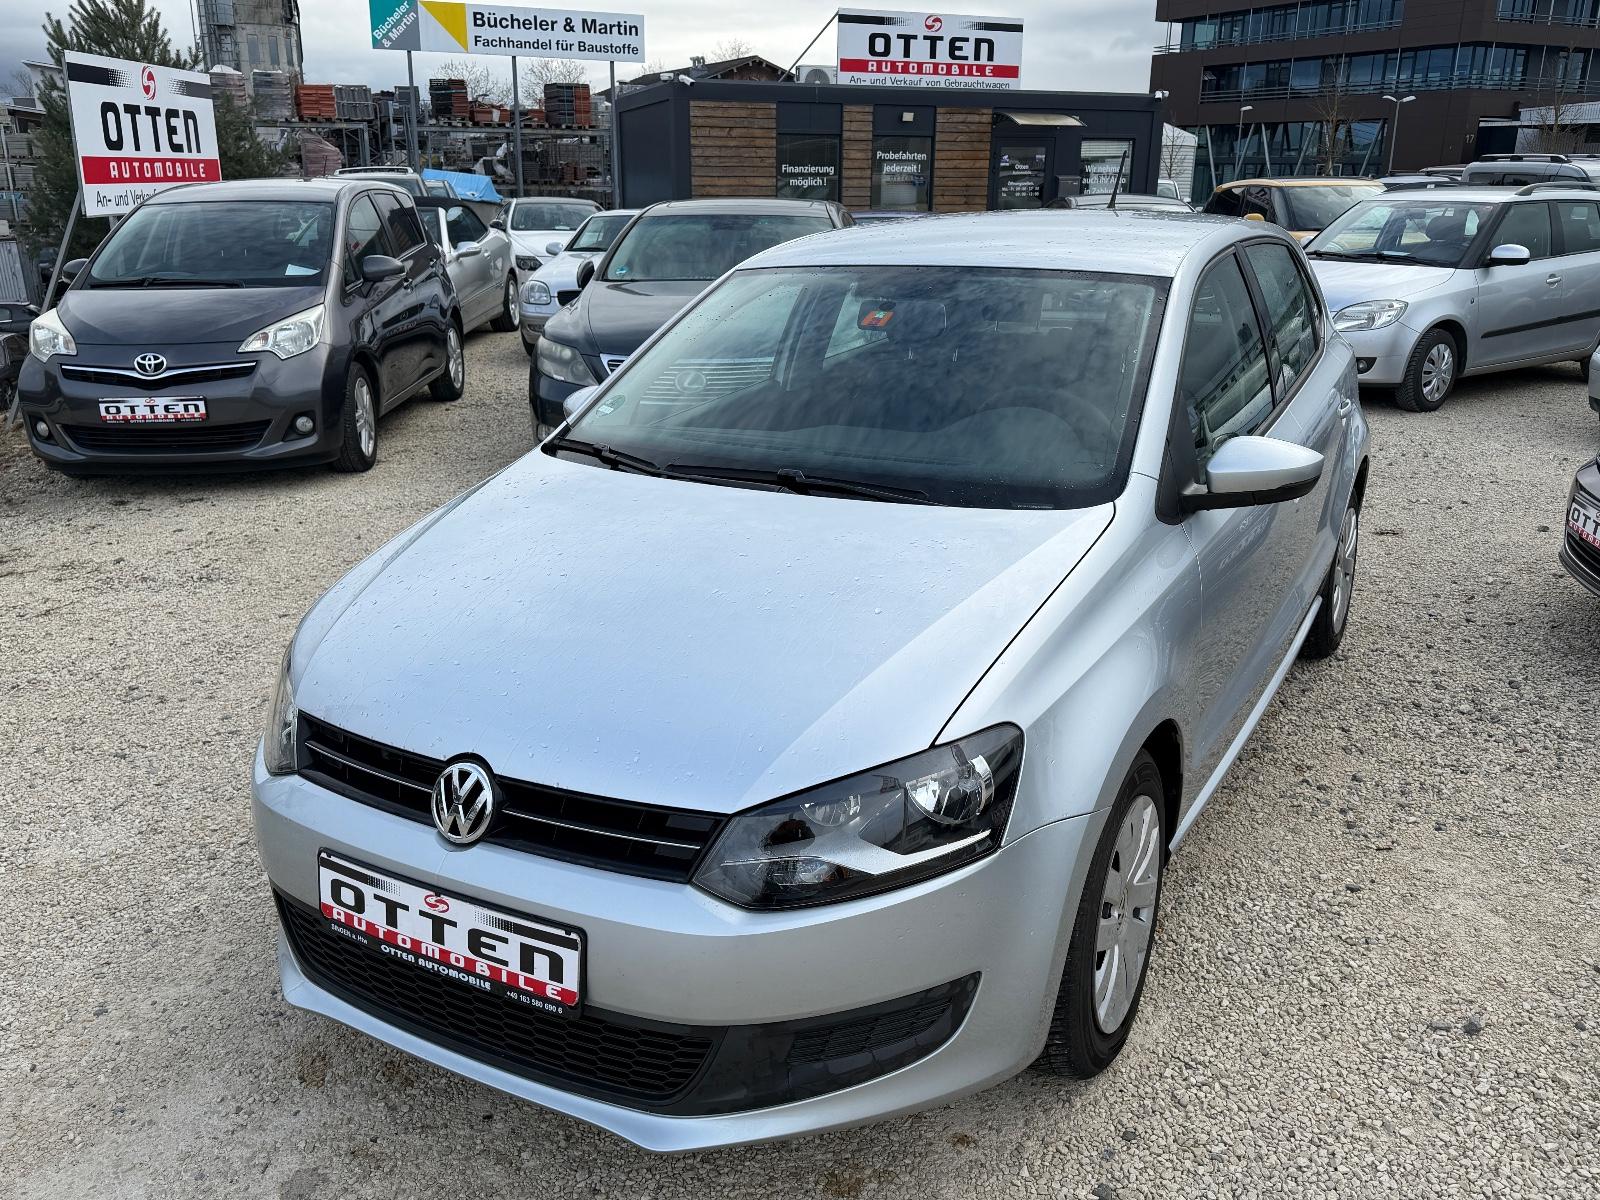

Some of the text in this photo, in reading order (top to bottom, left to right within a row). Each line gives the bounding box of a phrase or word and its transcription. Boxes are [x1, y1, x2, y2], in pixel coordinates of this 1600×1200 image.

[373, 0, 409, 40] Bücheler
[382, 12, 416, 48] & Martin
[472, 12, 638, 36] Bücheler & Martin
[474, 35, 639, 55] Fachhandel für Baustoffe
[868, 32, 995, 62] OTTEN
[868, 62, 994, 76] AUTOMOBILE
[850, 75, 866, 84] An-
[870, 76, 886, 85] und
[890, 77, 923, 86] Verkauf
[944, 79, 1010, 89] Gebrauchtwagen
[100, 101, 202, 154] OTTEN
[876, 151, 927, 161] Probefahrten
[110, 162, 206, 178] AUTOMOBILE
[782, 164, 834, 175] Finanzierung
[96, 190, 112, 207] An-
[114, 190, 129, 206] und
[104, 404, 200, 414] OTTEN
[330, 878, 564, 984] OTTEN
[332, 908, 562, 1000] AUTOMOBILE
[380, 944, 491, 990] OTTEN AUTOMOBILE
[506, 990, 518, 1000] +49
